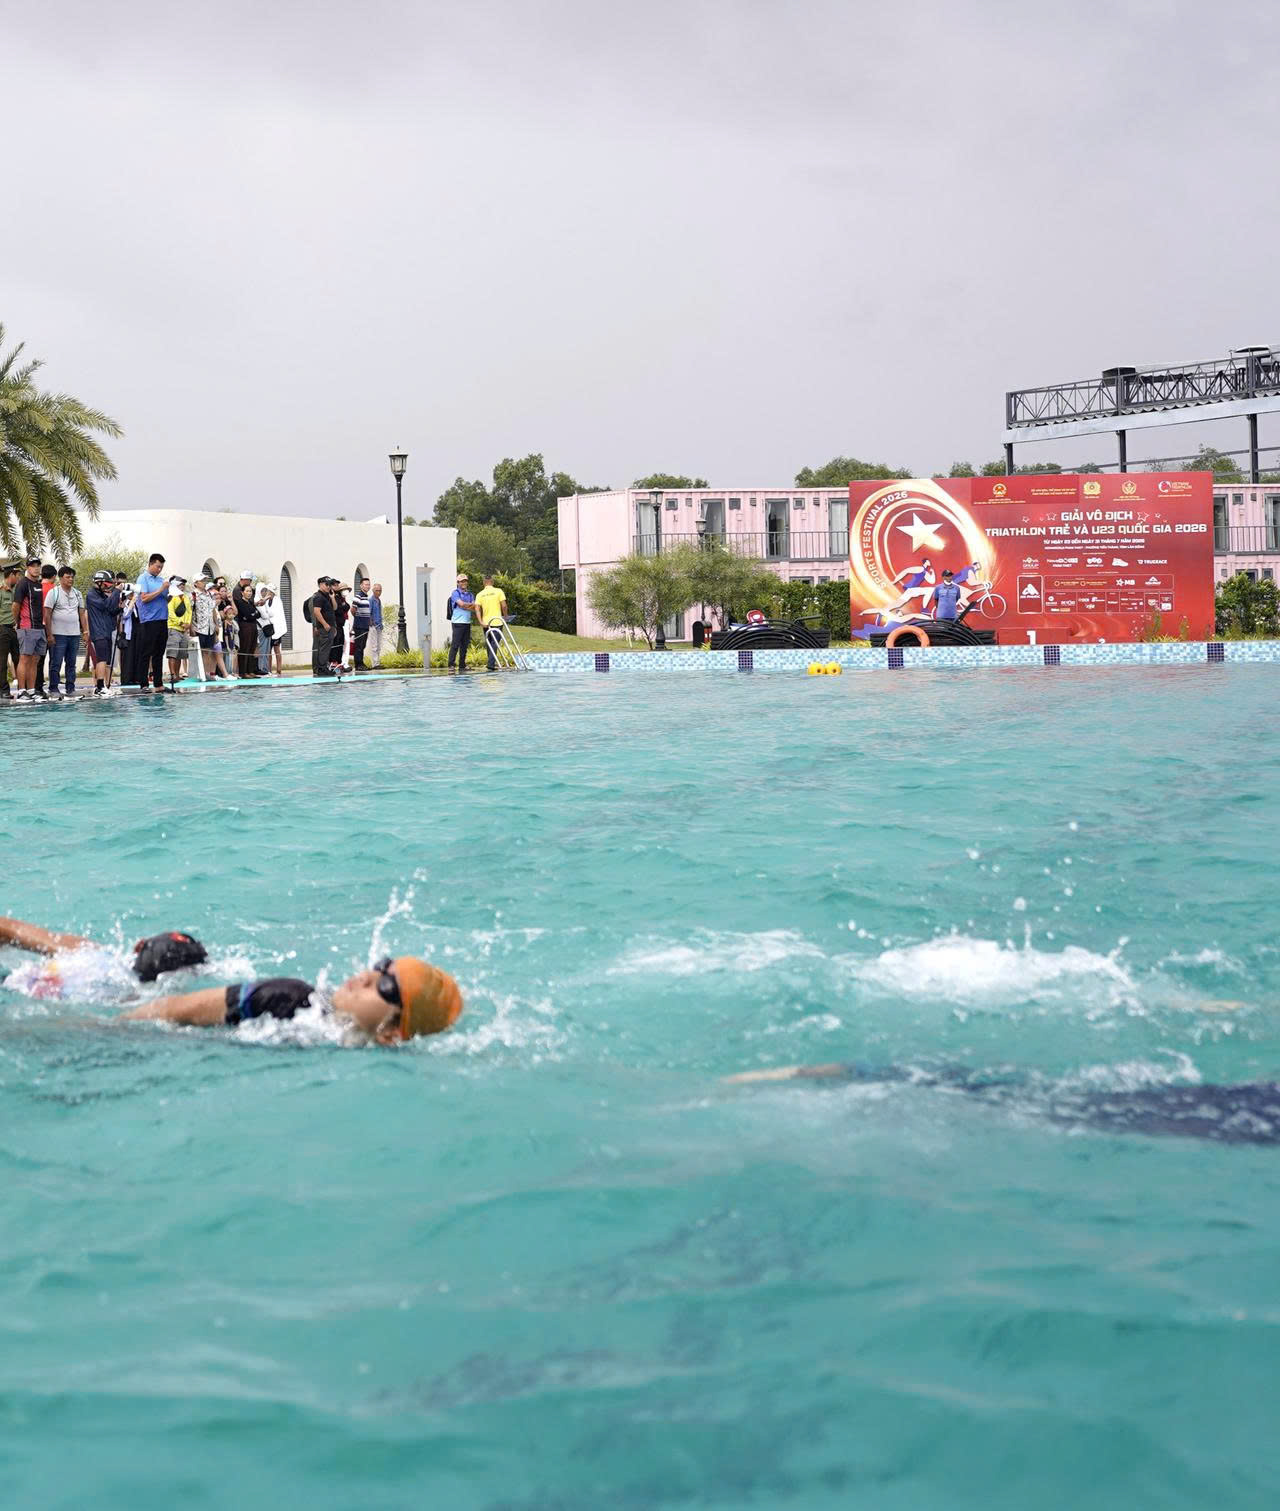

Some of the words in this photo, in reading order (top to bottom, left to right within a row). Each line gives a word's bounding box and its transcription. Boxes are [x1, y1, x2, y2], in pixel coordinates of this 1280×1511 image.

[881, 491, 908, 506] 2026
[1061, 508, 1083, 521] GIẢI
[1086, 509, 1102, 521] VÔ
[1105, 511, 1133, 522] ĐỊCH
[862, 504, 883, 549] FESTIVAL
[985, 527, 1046, 537] TRIATHLON
[1049, 523, 1070, 535] TRẺ
[1073, 523, 1088, 535] VÀ
[1092, 525, 1115, 535] U23
[1118, 521, 1150, 535] QUỐC
[1153, 524, 1172, 533] GIA
[1175, 523, 1207, 533] 2026
[864, 550, 887, 590] SPORTS
[1026, 630, 1036, 645] 1
